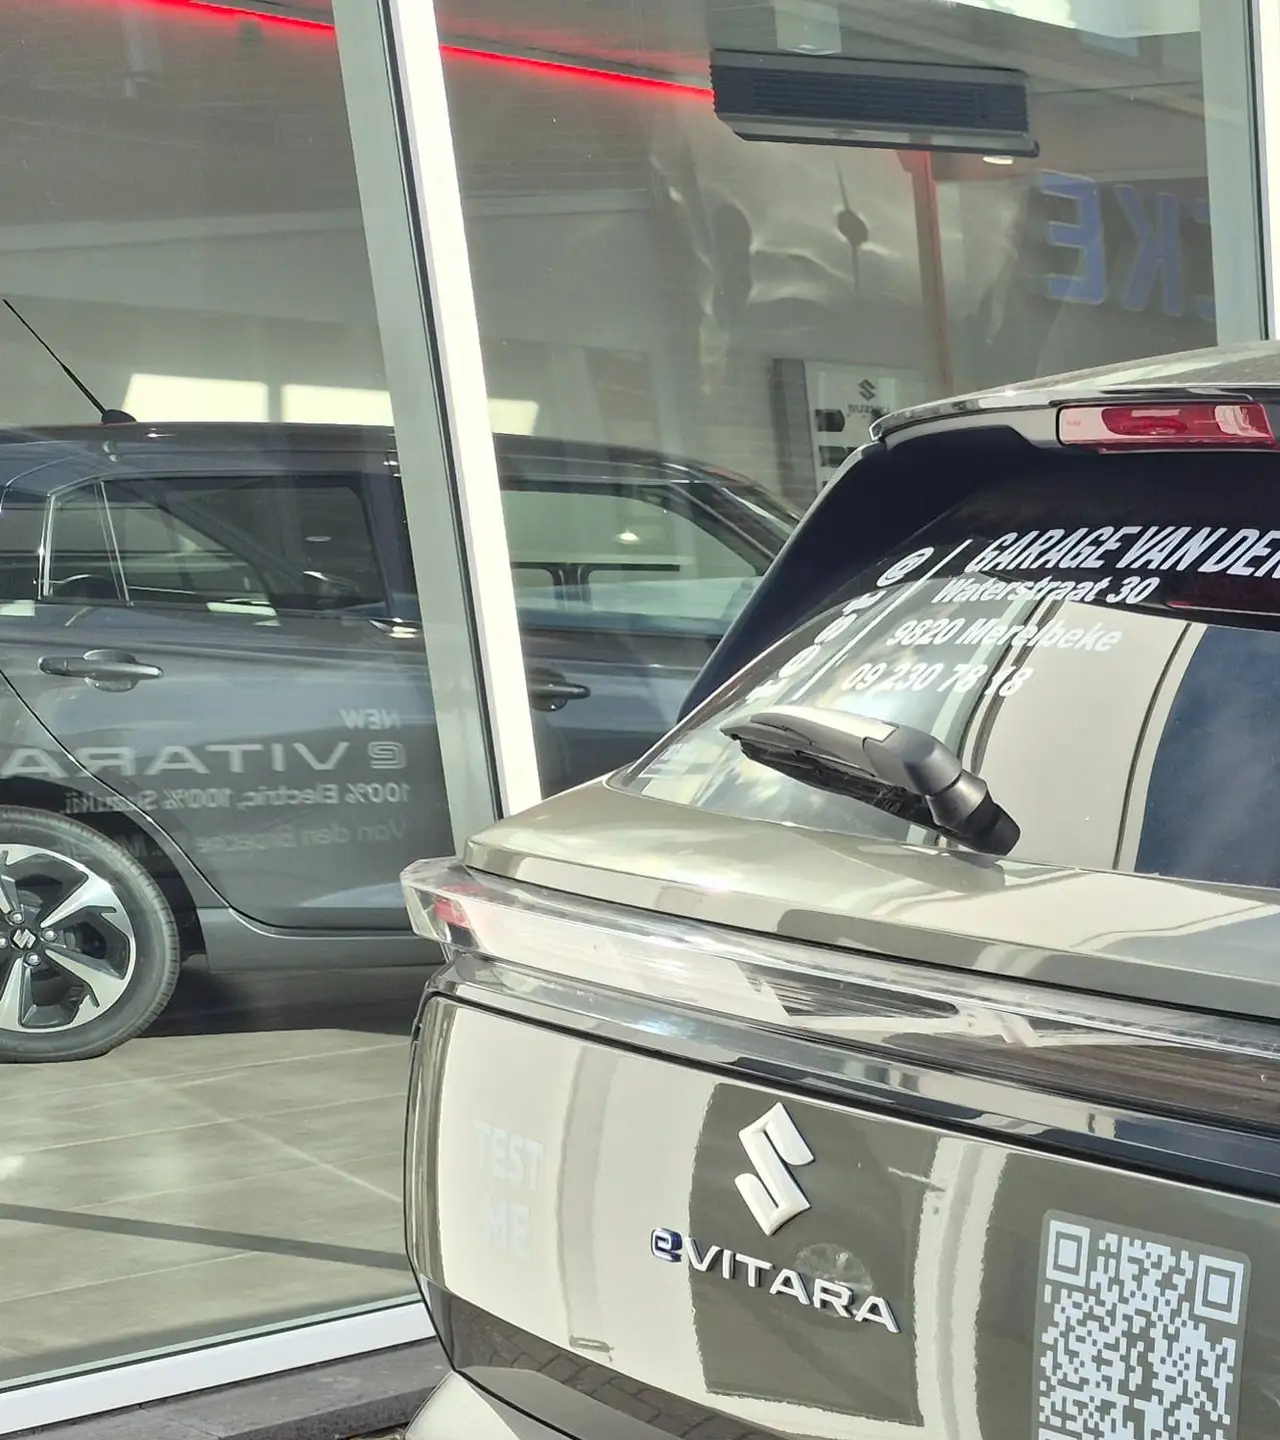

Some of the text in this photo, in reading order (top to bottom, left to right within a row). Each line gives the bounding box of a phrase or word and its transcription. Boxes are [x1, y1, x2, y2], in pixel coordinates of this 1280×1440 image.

[963, 526, 1143, 573] GARAGE
[1115, 526, 1227, 571] VAN
[932, 575, 1161, 605] Waterstraat 30
[887, 617, 1124, 653] 9820 Merelbeke
[843, 663, 1036, 697] 09 230 78 18
